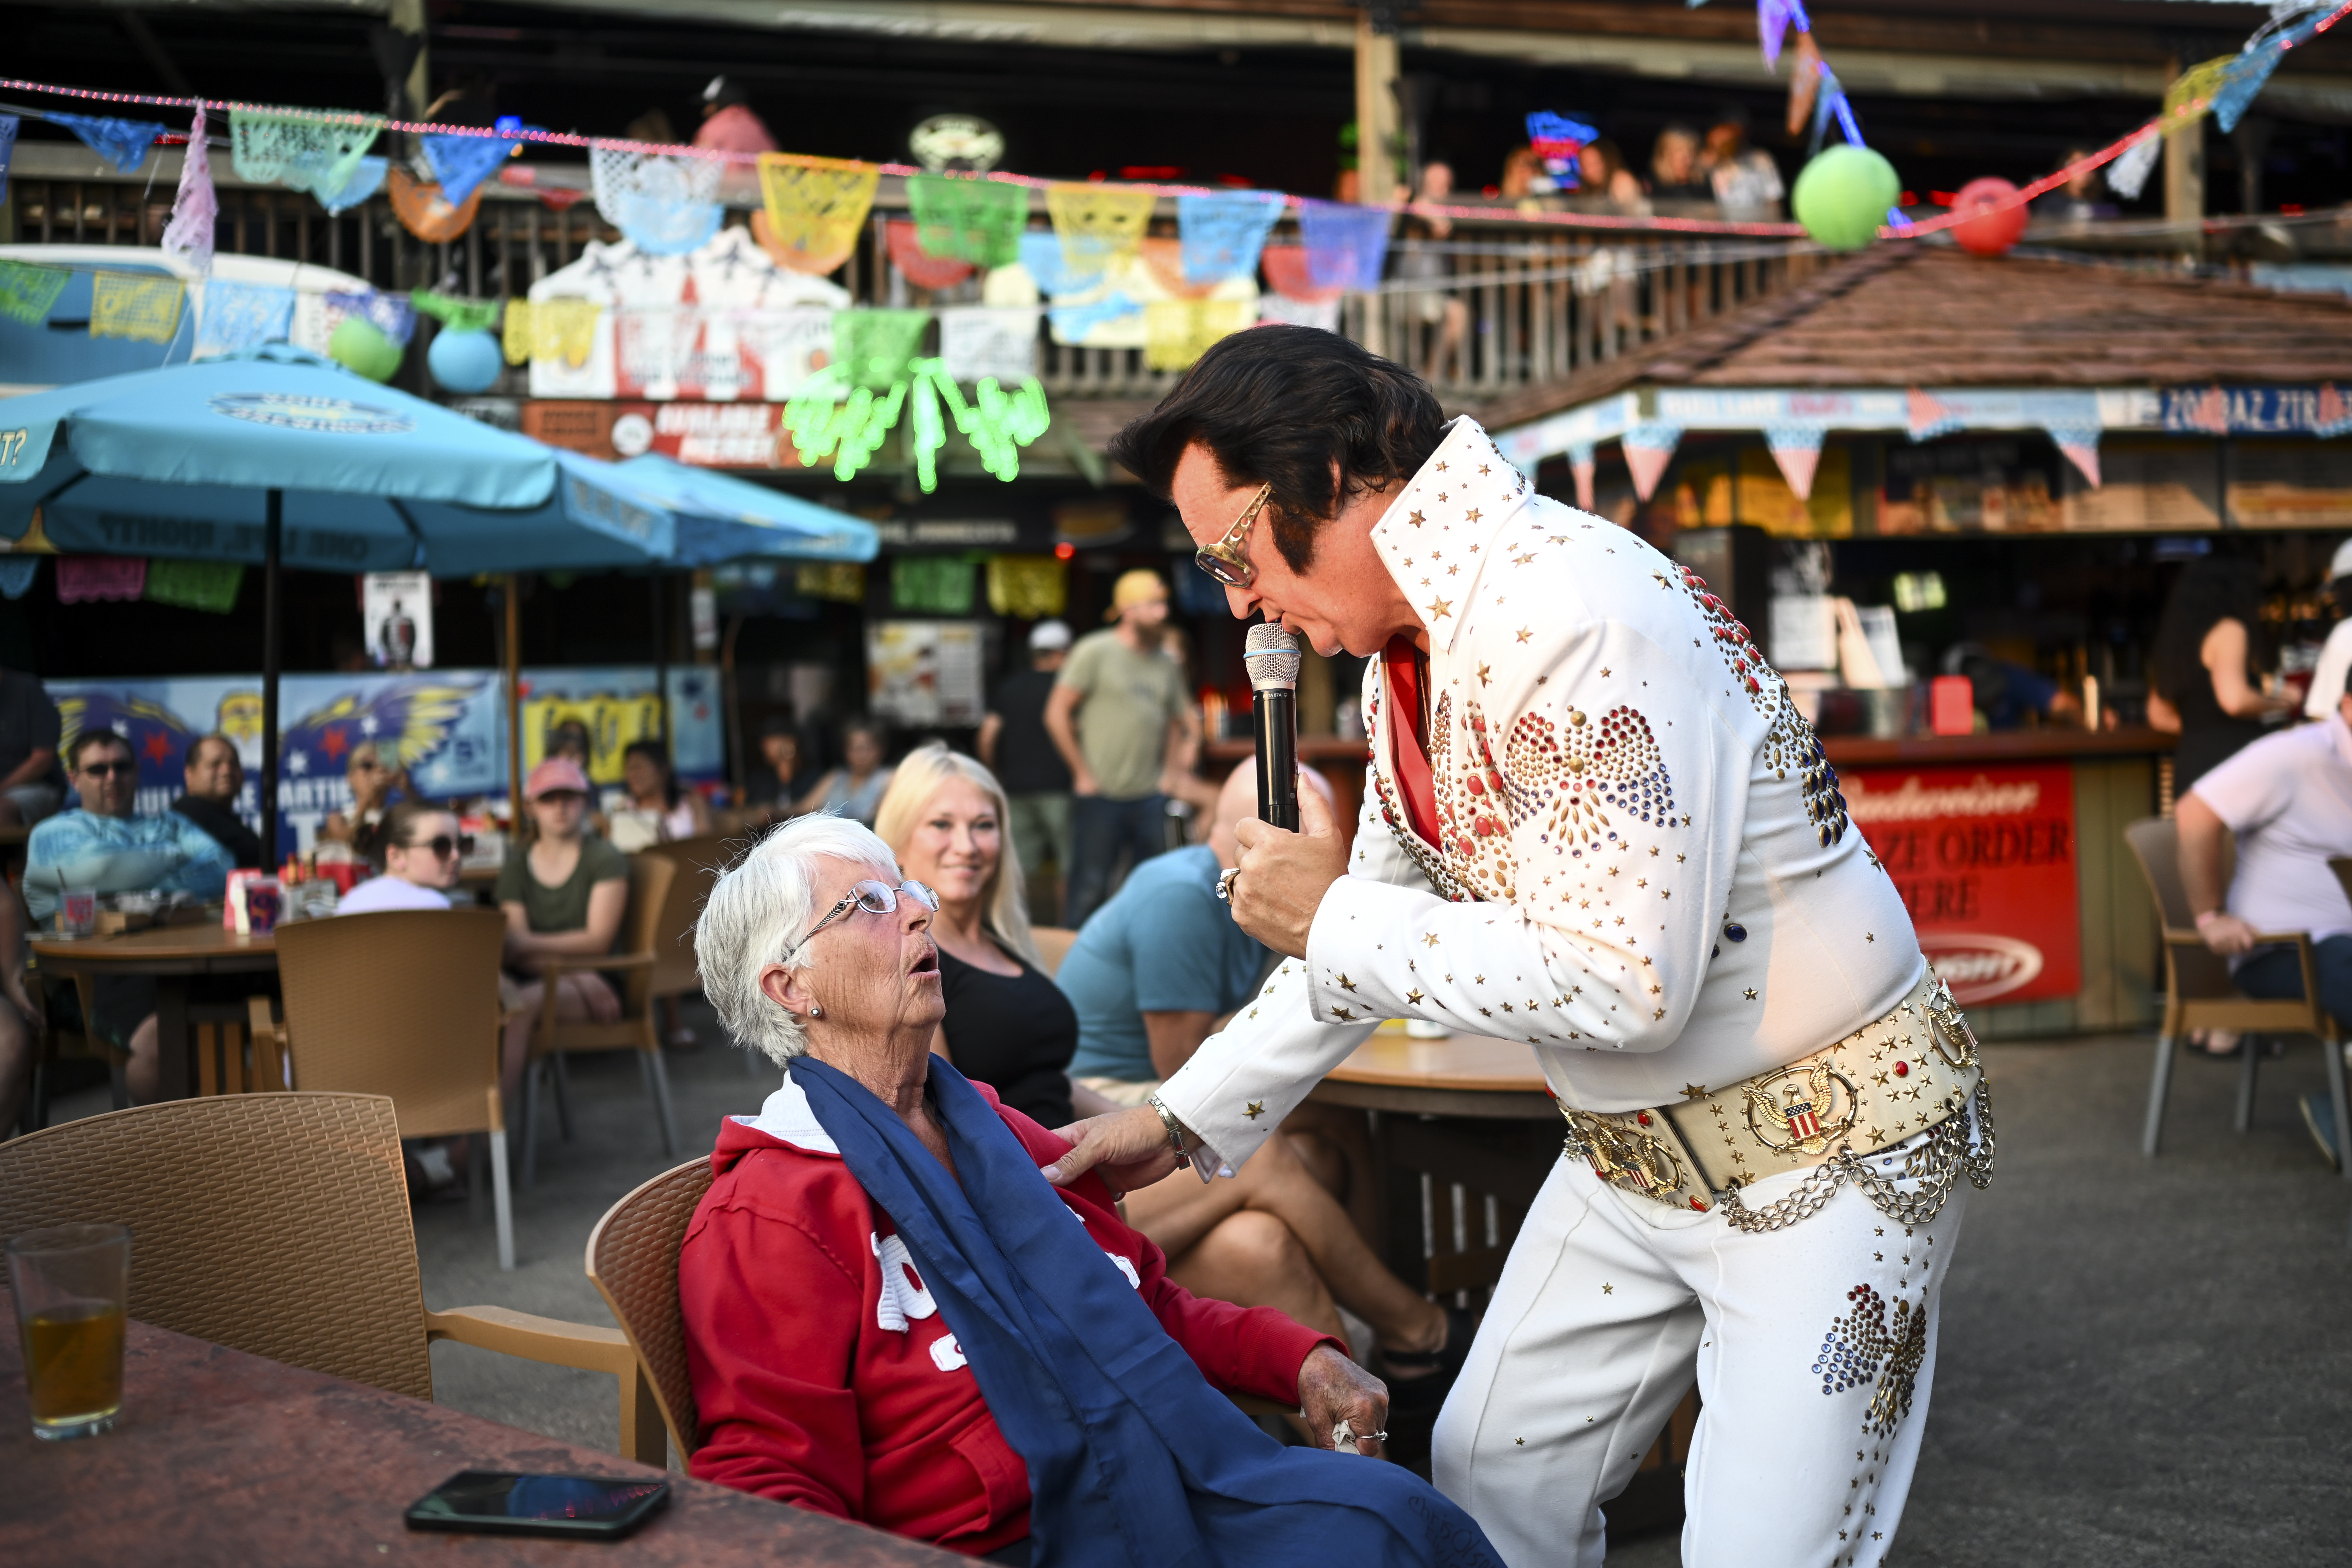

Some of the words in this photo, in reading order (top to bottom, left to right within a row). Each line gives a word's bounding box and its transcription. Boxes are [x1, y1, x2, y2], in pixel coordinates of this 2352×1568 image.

[0, 428, 27, 466] T?
[1939, 817, 2070, 871] ORDER
[1900, 880, 1980, 928] ERE
